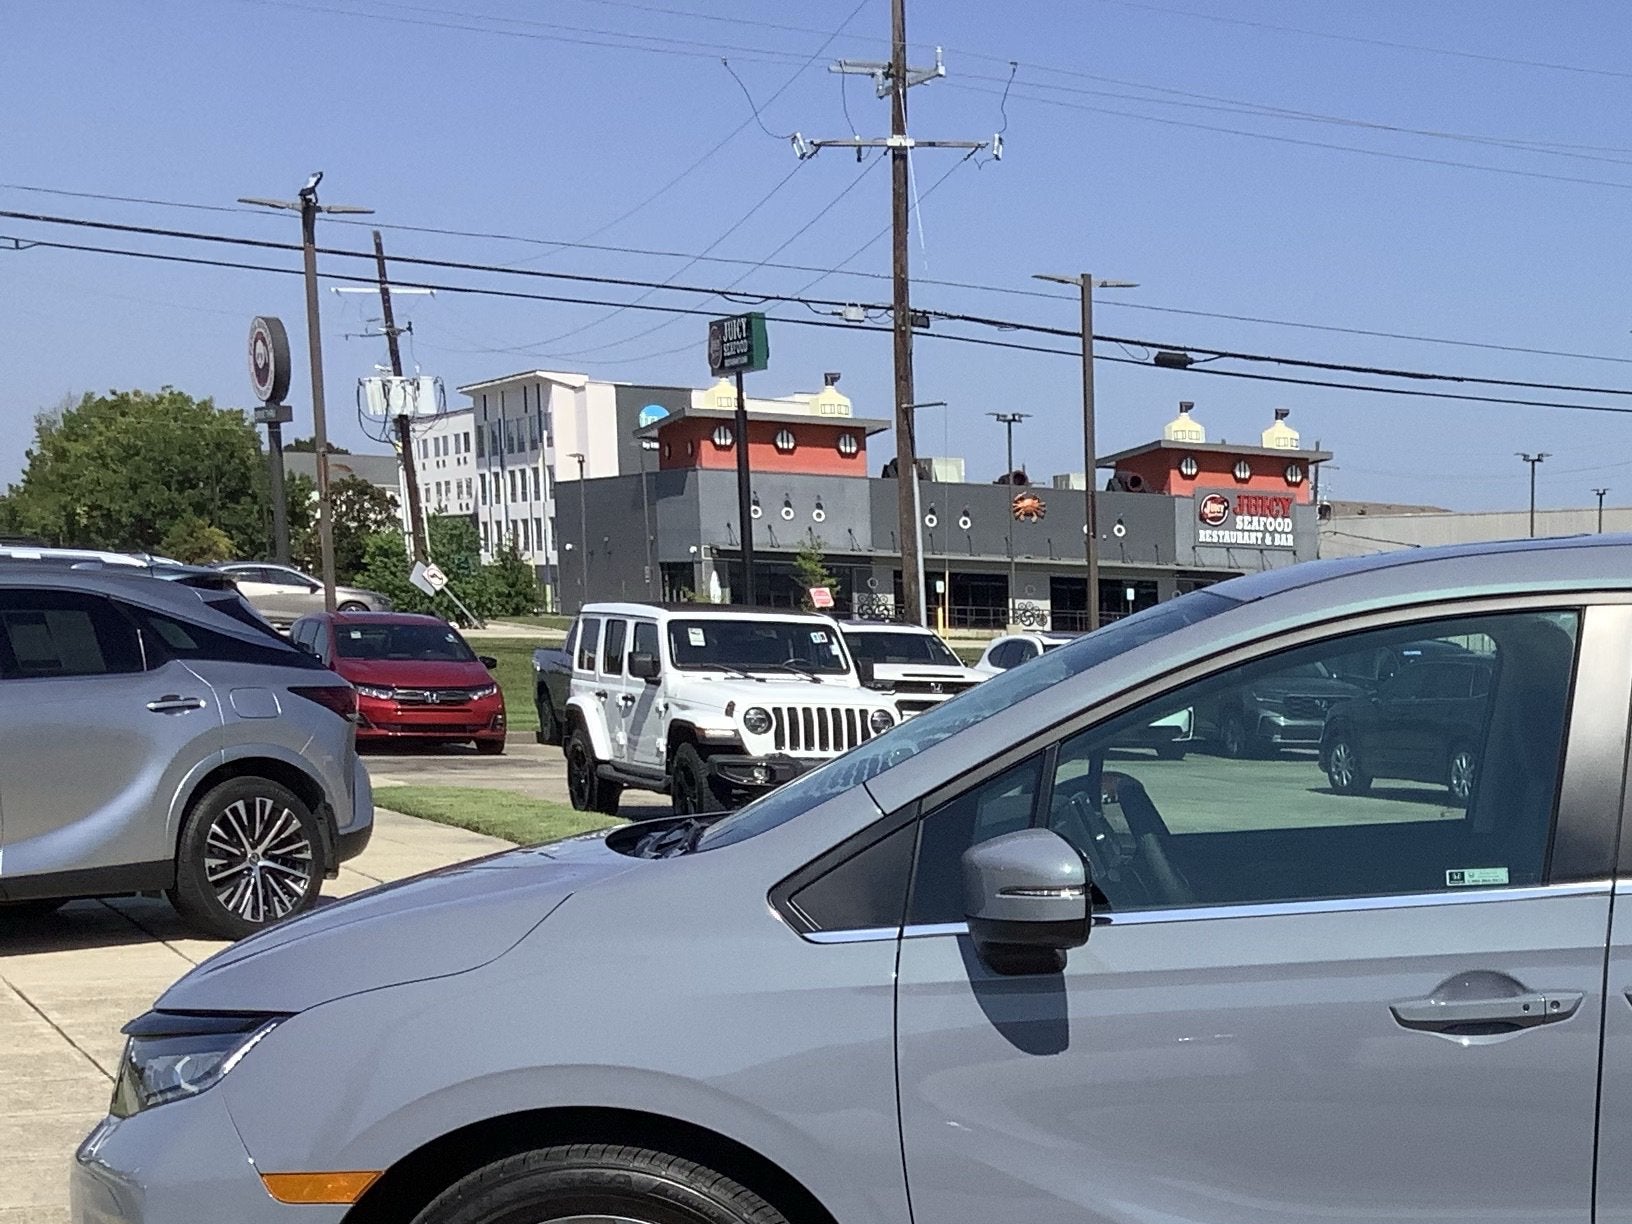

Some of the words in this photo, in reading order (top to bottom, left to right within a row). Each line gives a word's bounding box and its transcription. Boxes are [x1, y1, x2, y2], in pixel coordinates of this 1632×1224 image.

[723, 317, 747, 342] JUICY
[1233, 495, 1293, 518] JUICY
[1235, 515, 1293, 533] SEAFOOD
[1198, 529, 1263, 545] RESTAURANT
[1264, 532, 1272, 546] &
[1274, 533, 1294, 547] BAR
